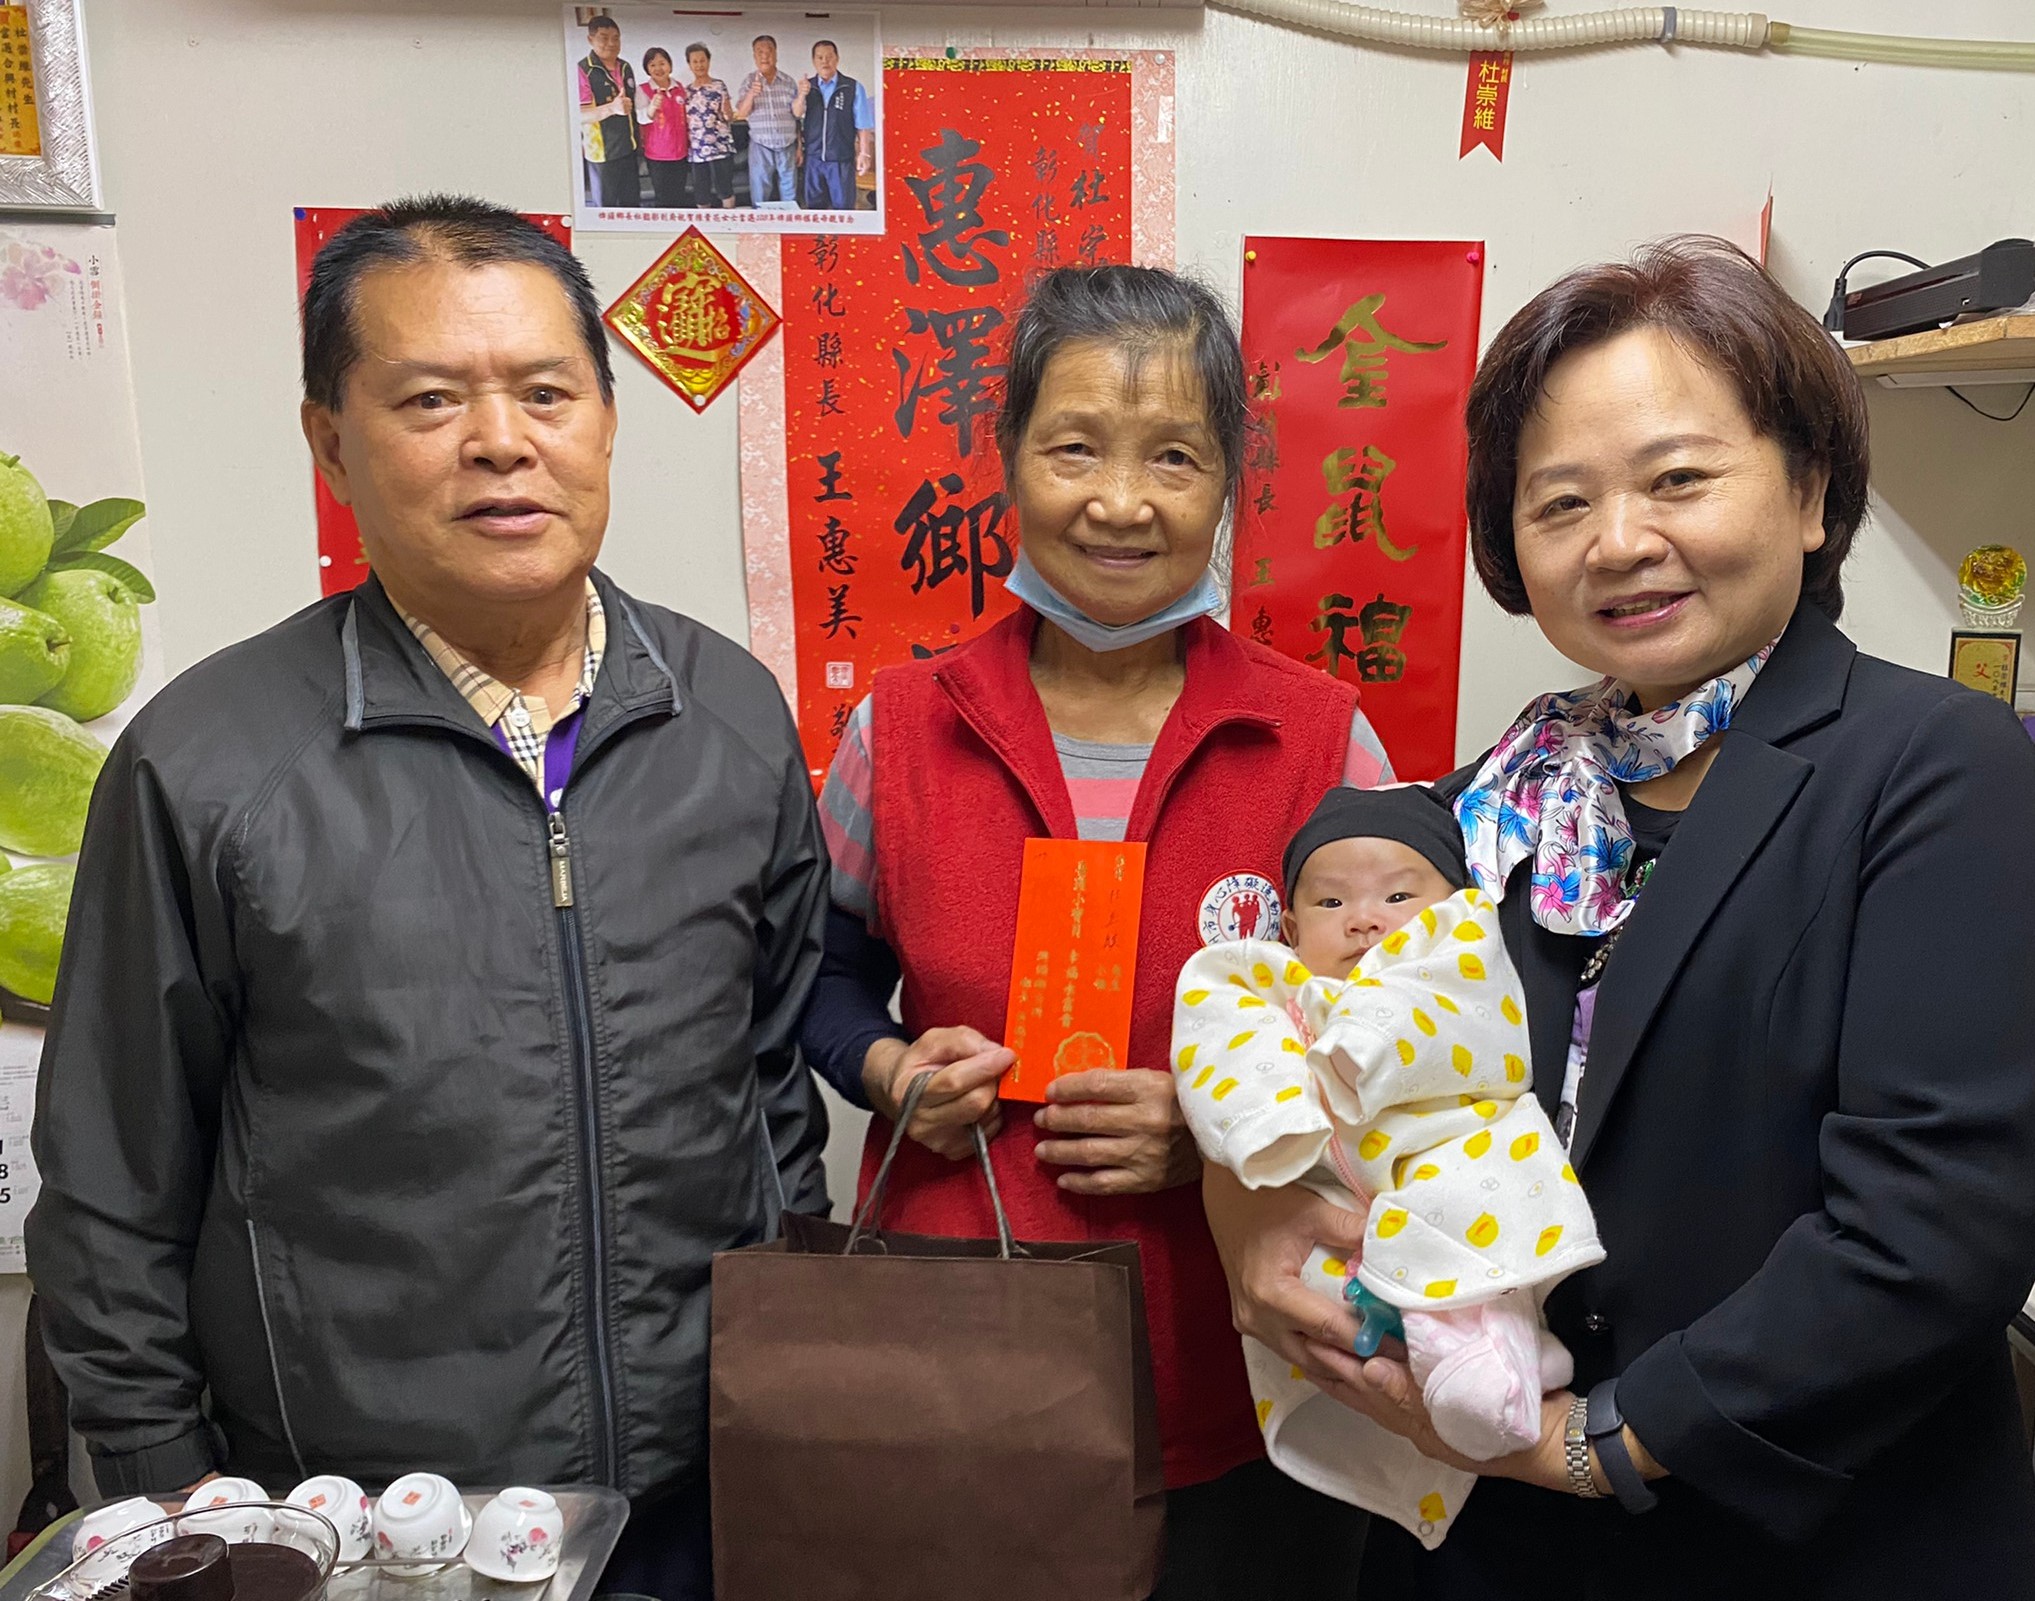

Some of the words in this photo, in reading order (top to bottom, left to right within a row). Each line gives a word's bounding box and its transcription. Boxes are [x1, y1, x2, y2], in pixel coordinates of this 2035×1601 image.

[1473, 59, 1500, 130] 杜崇維
[808, 234, 846, 417] 彰化縣長
[893, 128, 1018, 658] 惠澤鄉
[813, 451, 863, 640] 王惠美
